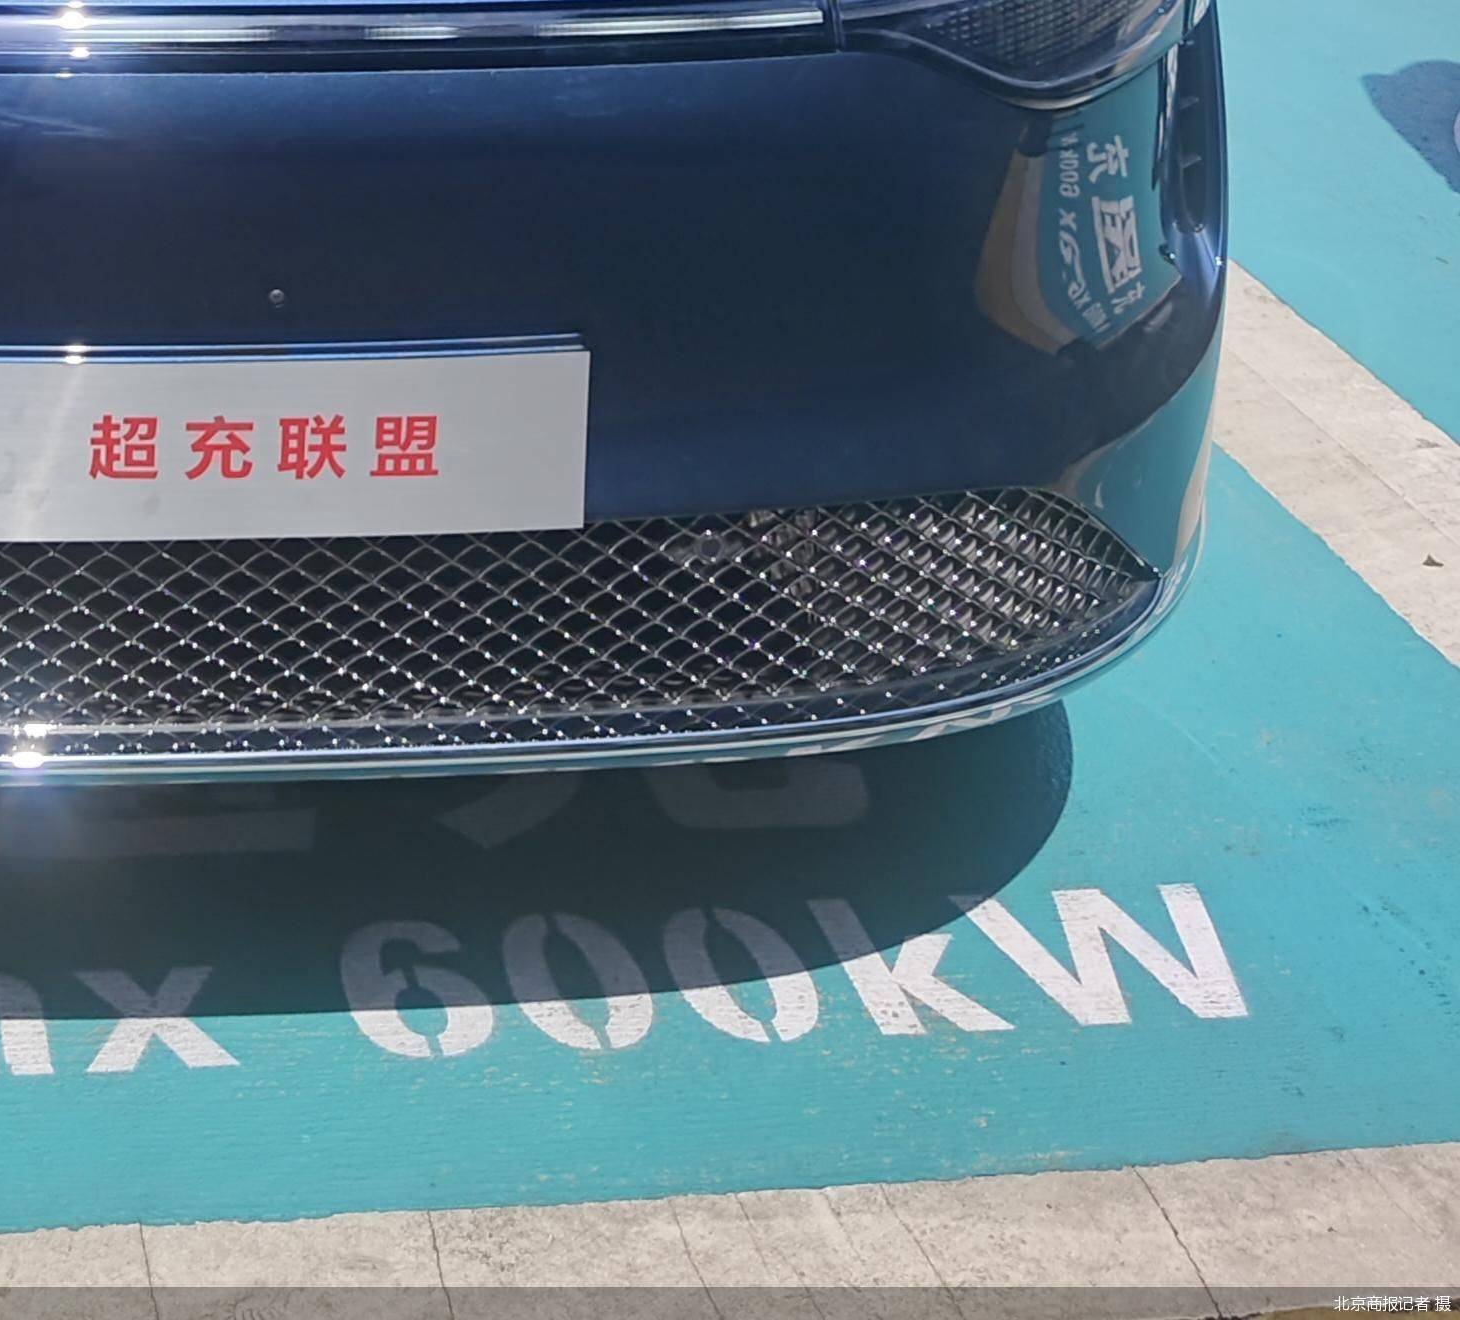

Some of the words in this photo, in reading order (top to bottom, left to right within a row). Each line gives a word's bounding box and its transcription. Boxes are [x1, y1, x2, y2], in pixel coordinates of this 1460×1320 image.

[89, 414, 439, 481] 超充联盟
[341, 883, 1249, 1058] 600kW
